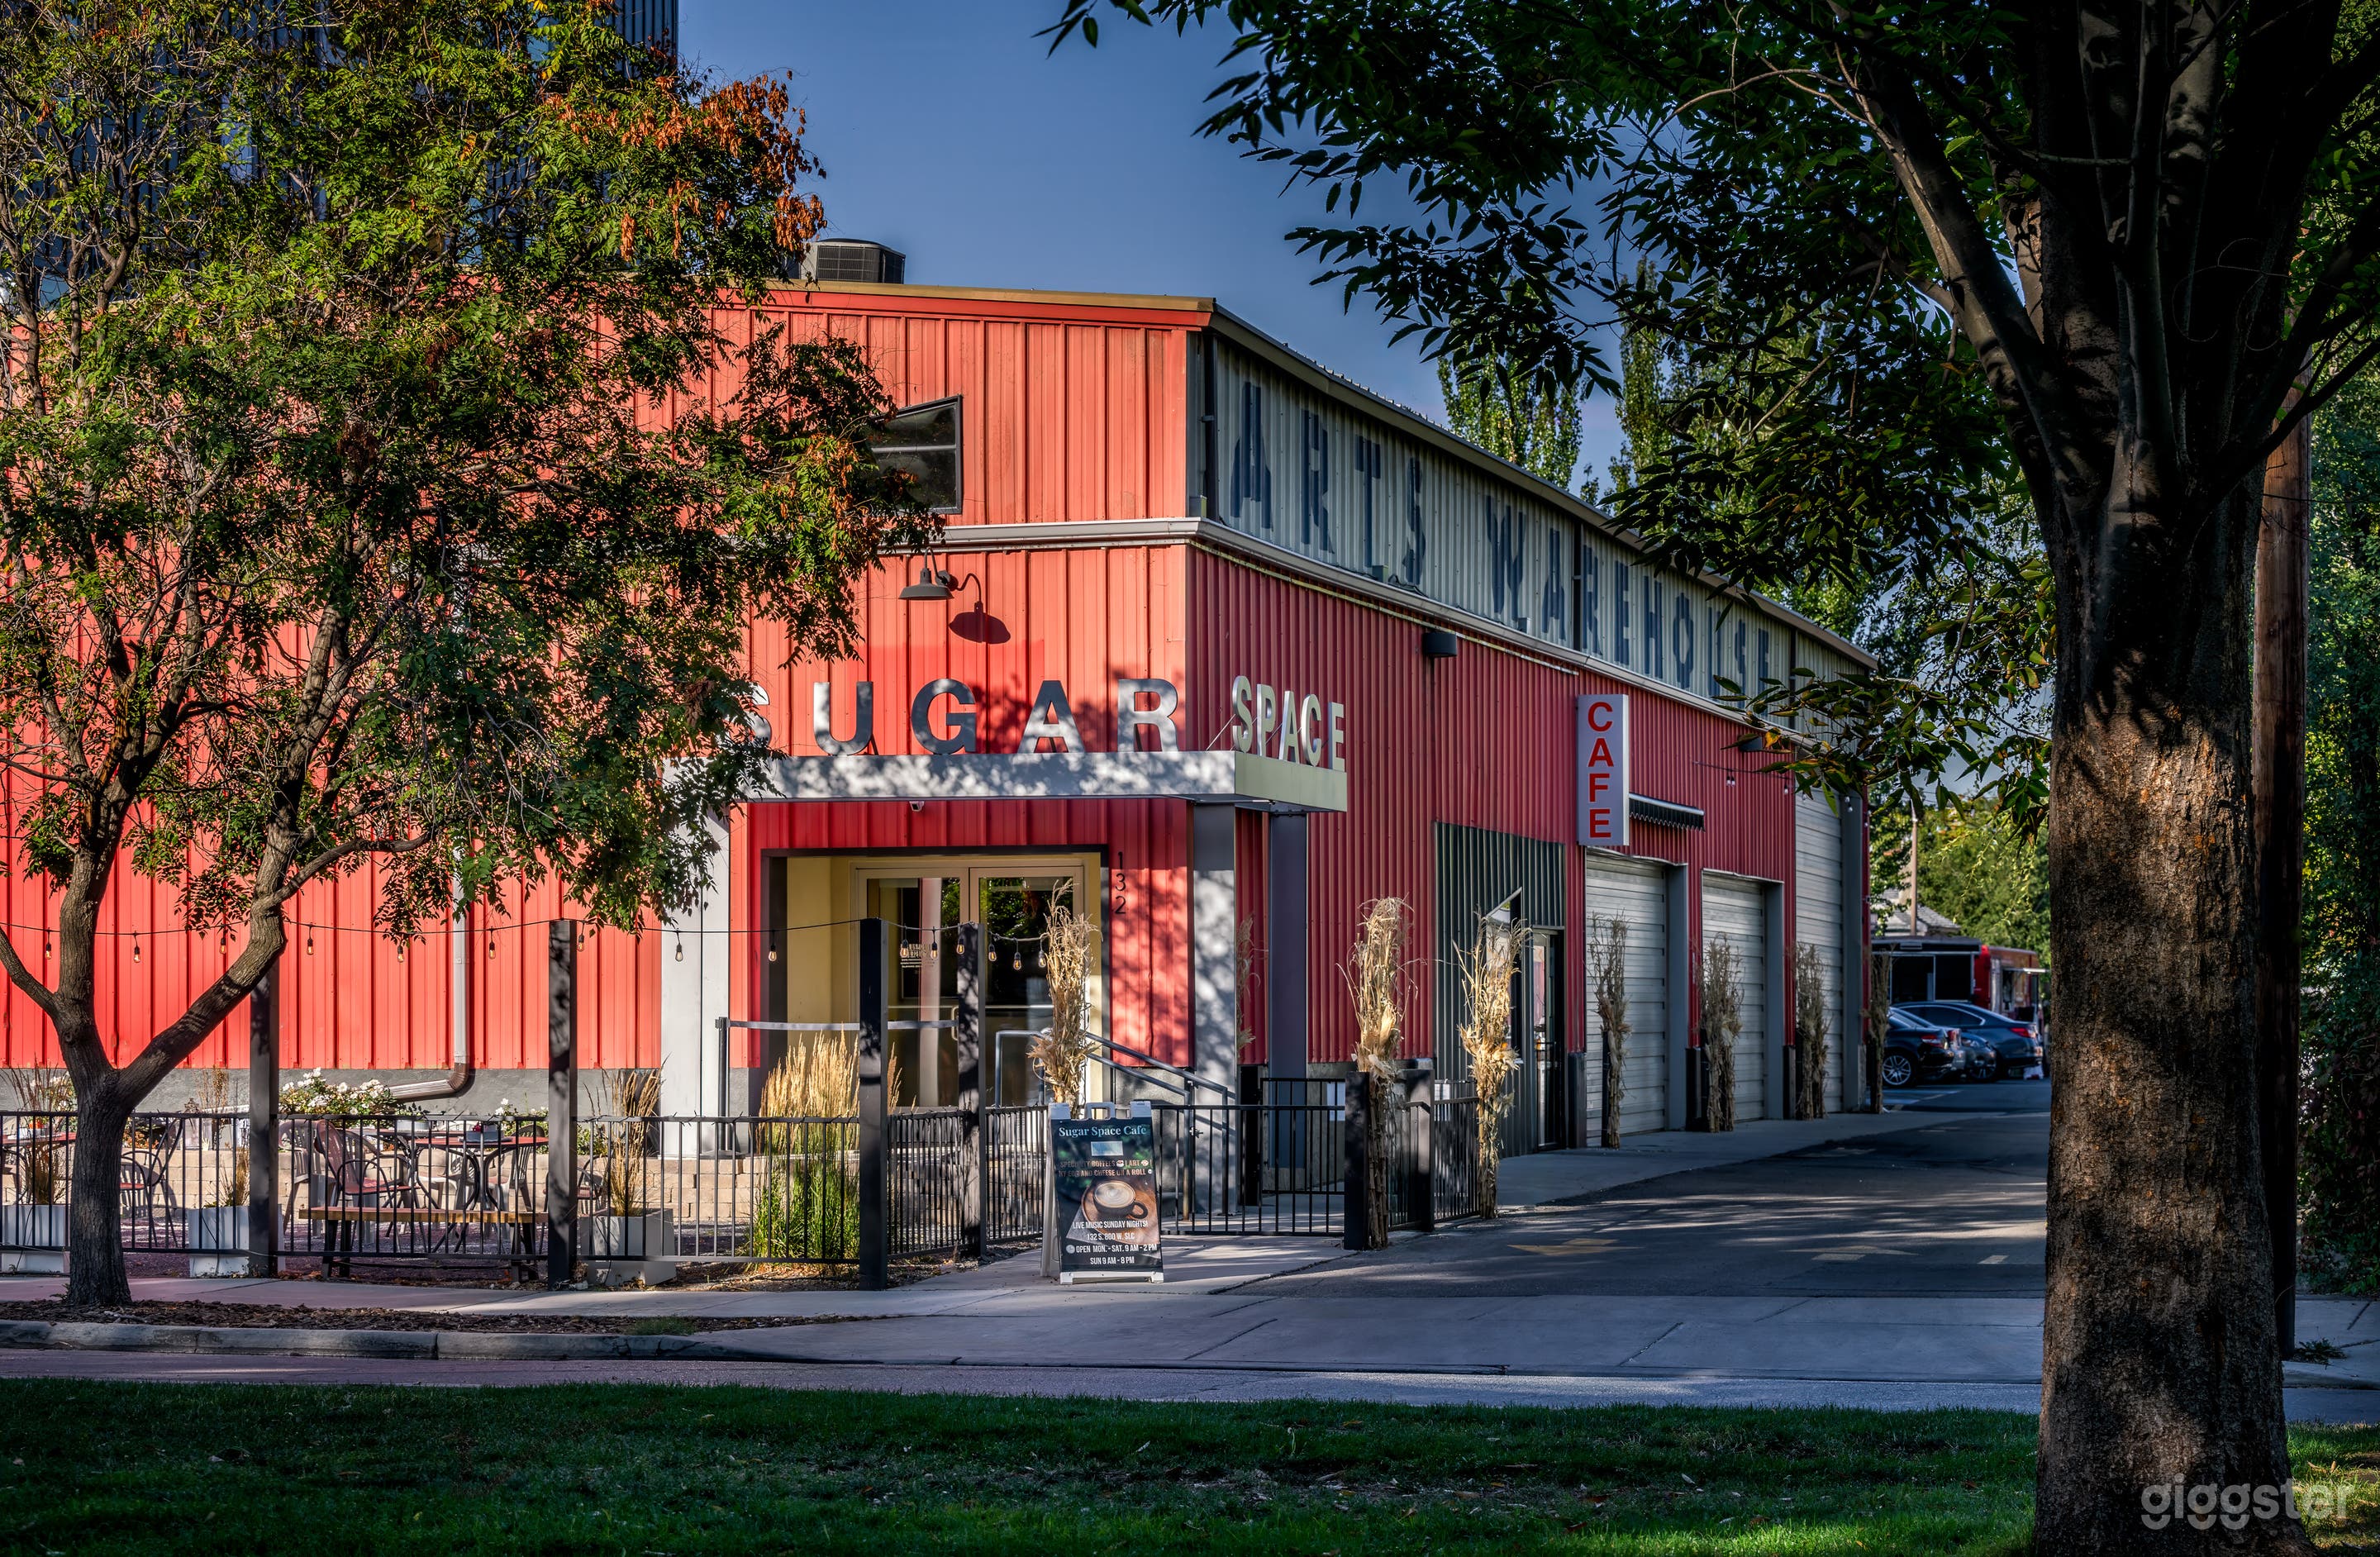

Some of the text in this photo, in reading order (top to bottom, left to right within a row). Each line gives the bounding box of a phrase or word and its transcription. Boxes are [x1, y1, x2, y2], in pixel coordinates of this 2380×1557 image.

[1230, 382, 1769, 717] ARTS WAREHOUSE
[1232, 675, 1345, 772] SPACE
[1587, 701, 1614, 838] CAFE
[1115, 851, 1126, 914] 132
[1059, 1127, 1089, 1138] Sugar
[1091, 1126, 1121, 1137] Space
[1093, 1169, 1116, 1177] CHEESE
[1131, 1168, 1146, 1176] ROLL
[1103, 1220, 1126, 1228] SUNDAY
[1126, 1220, 1148, 1228] NIGHTS!
[1092, 1245, 1107, 1253] MON.
[1111, 1244, 1124, 1252] SAT.
[1148, 1243, 1157, 1251] PM
[1107, 1256, 1116, 1264] AM
